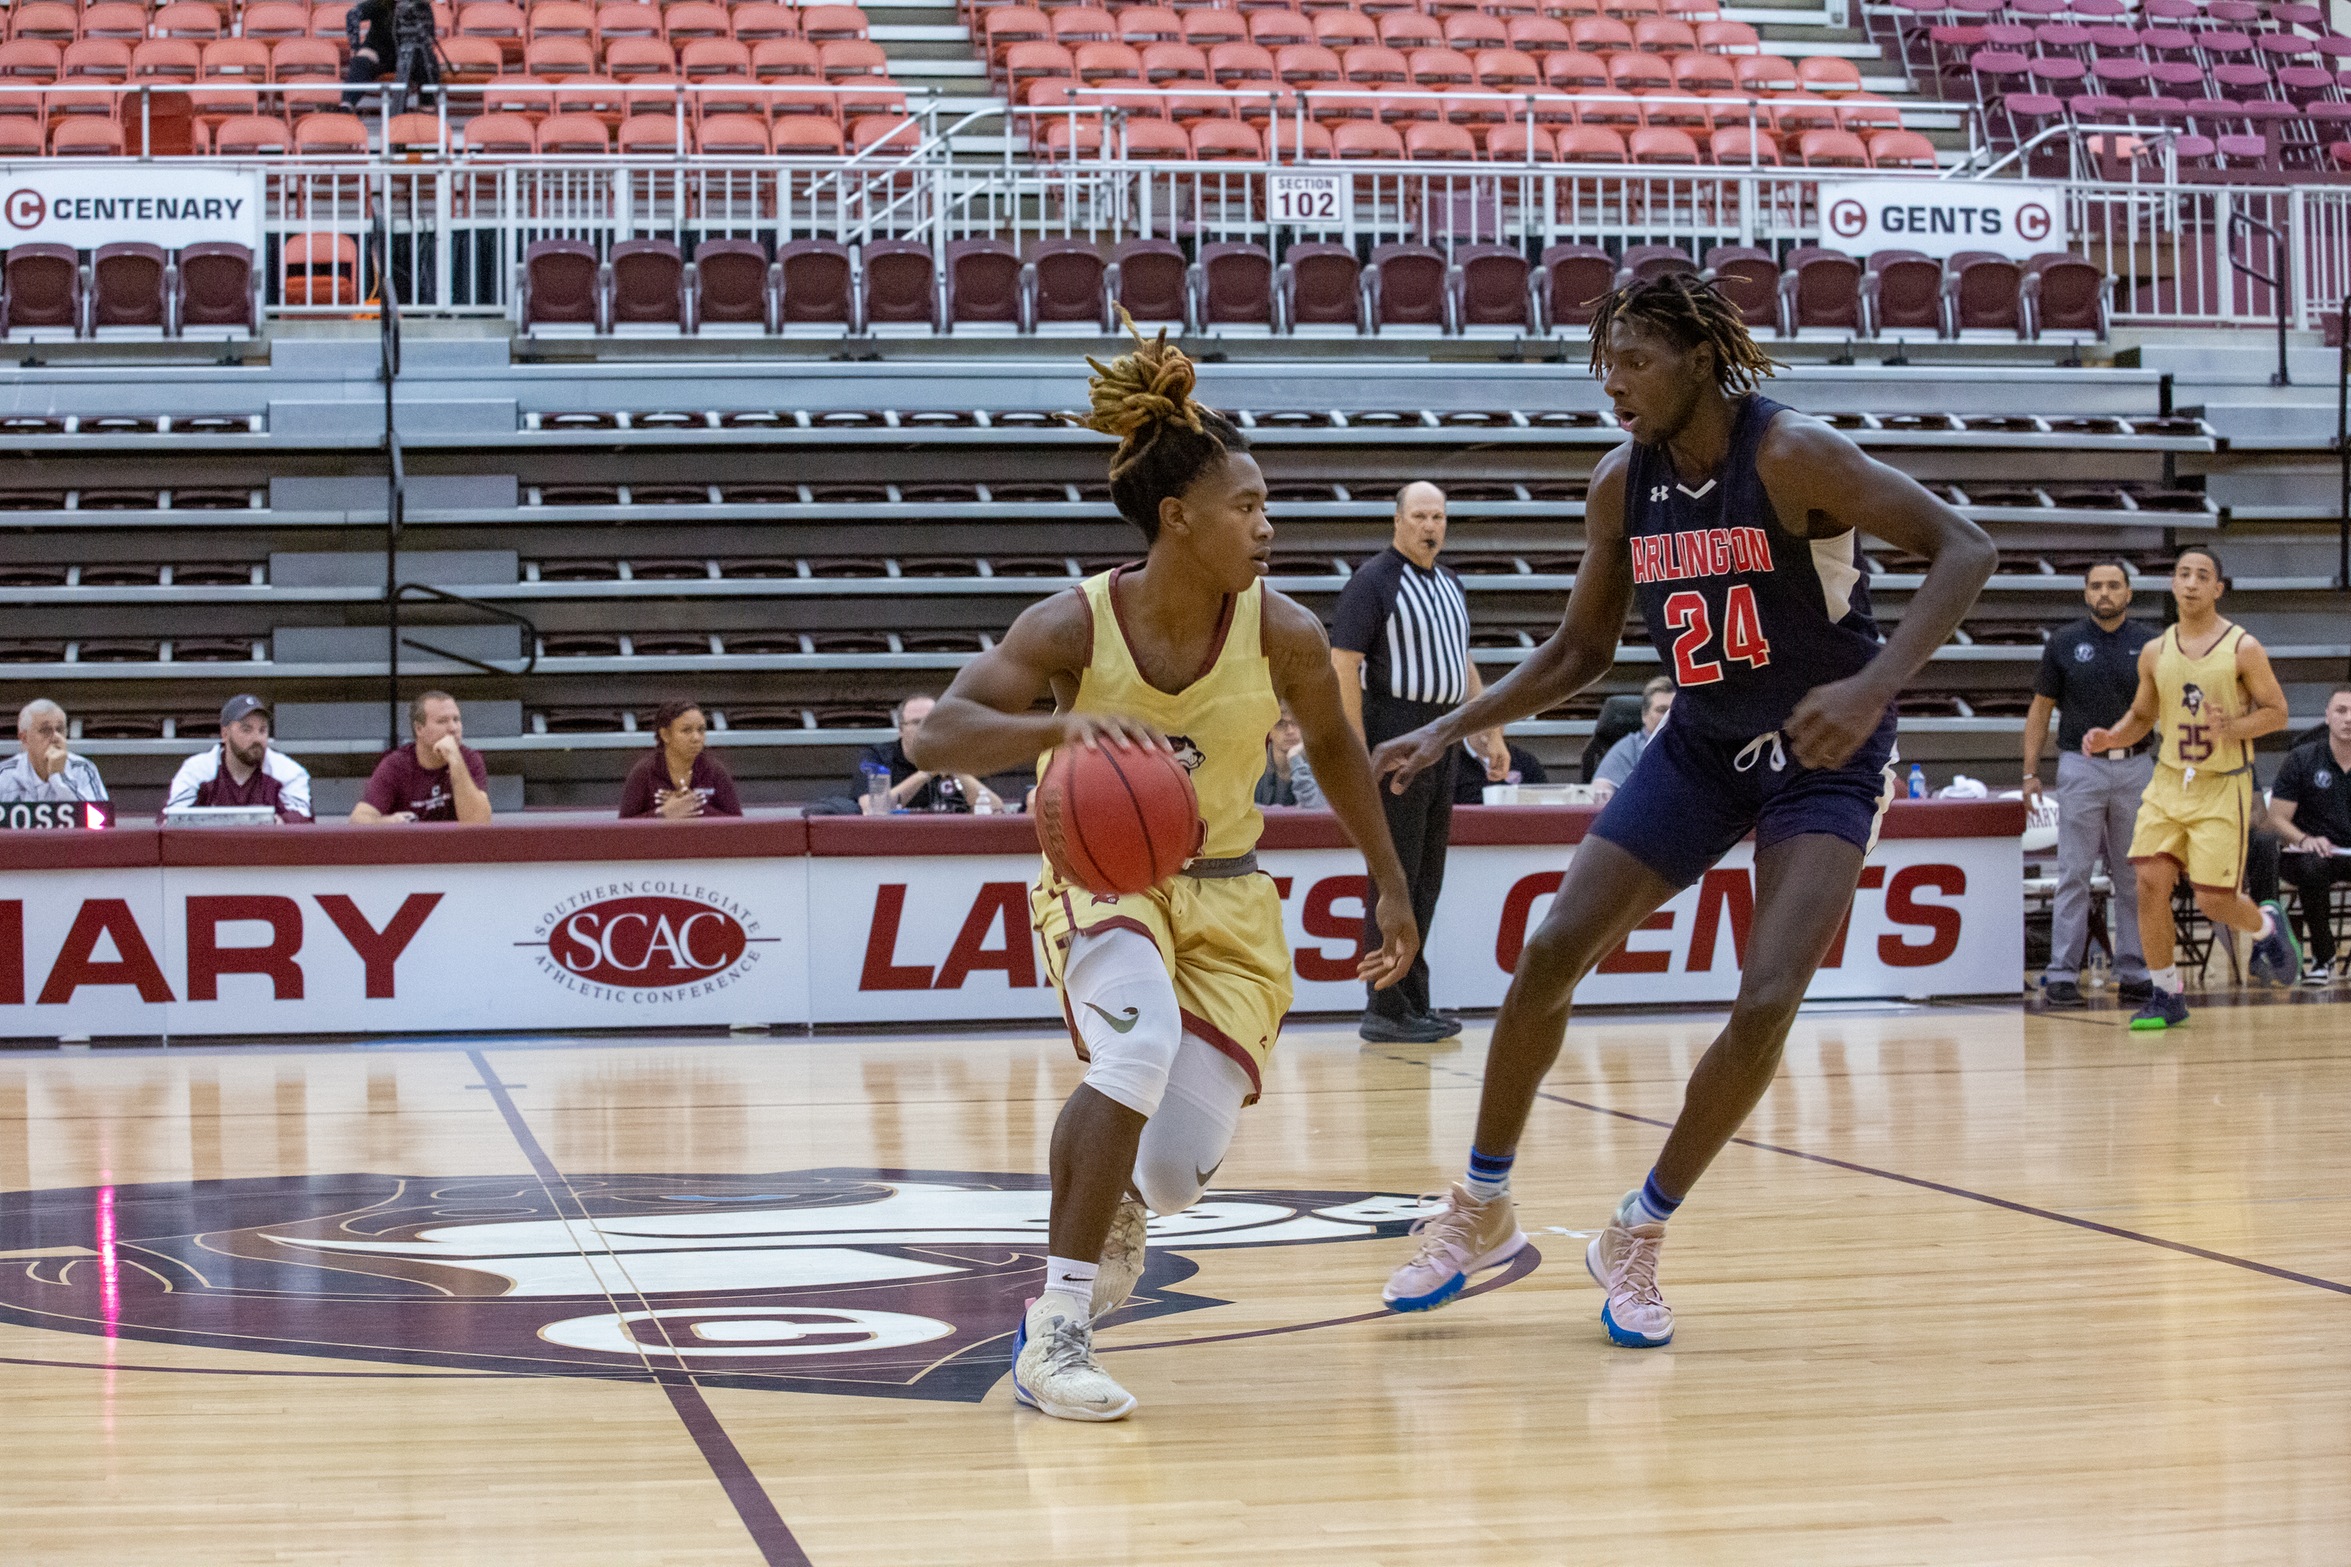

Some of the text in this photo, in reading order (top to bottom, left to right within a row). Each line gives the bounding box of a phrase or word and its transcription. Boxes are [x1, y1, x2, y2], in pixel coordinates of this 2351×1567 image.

[1278, 178, 1334, 190] SECTION
[1278, 192, 1335, 217] 102
[53, 197, 244, 221] CENTENARY
[1881, 205, 2003, 234] GENTS
[1630, 526, 1775, 584] ARLINGON
[1663, 583, 1772, 688] 24
[2177, 724, 2214, 763] 25
[0, 803, 75, 829] OSS
[534, 880, 761, 937] SOUTHERN COLLEGIATE
[0, 892, 446, 1005] ARY
[565, 910, 728, 973] SCAC
[534, 949, 762, 1005] ATHLETIC CONFERENCE
